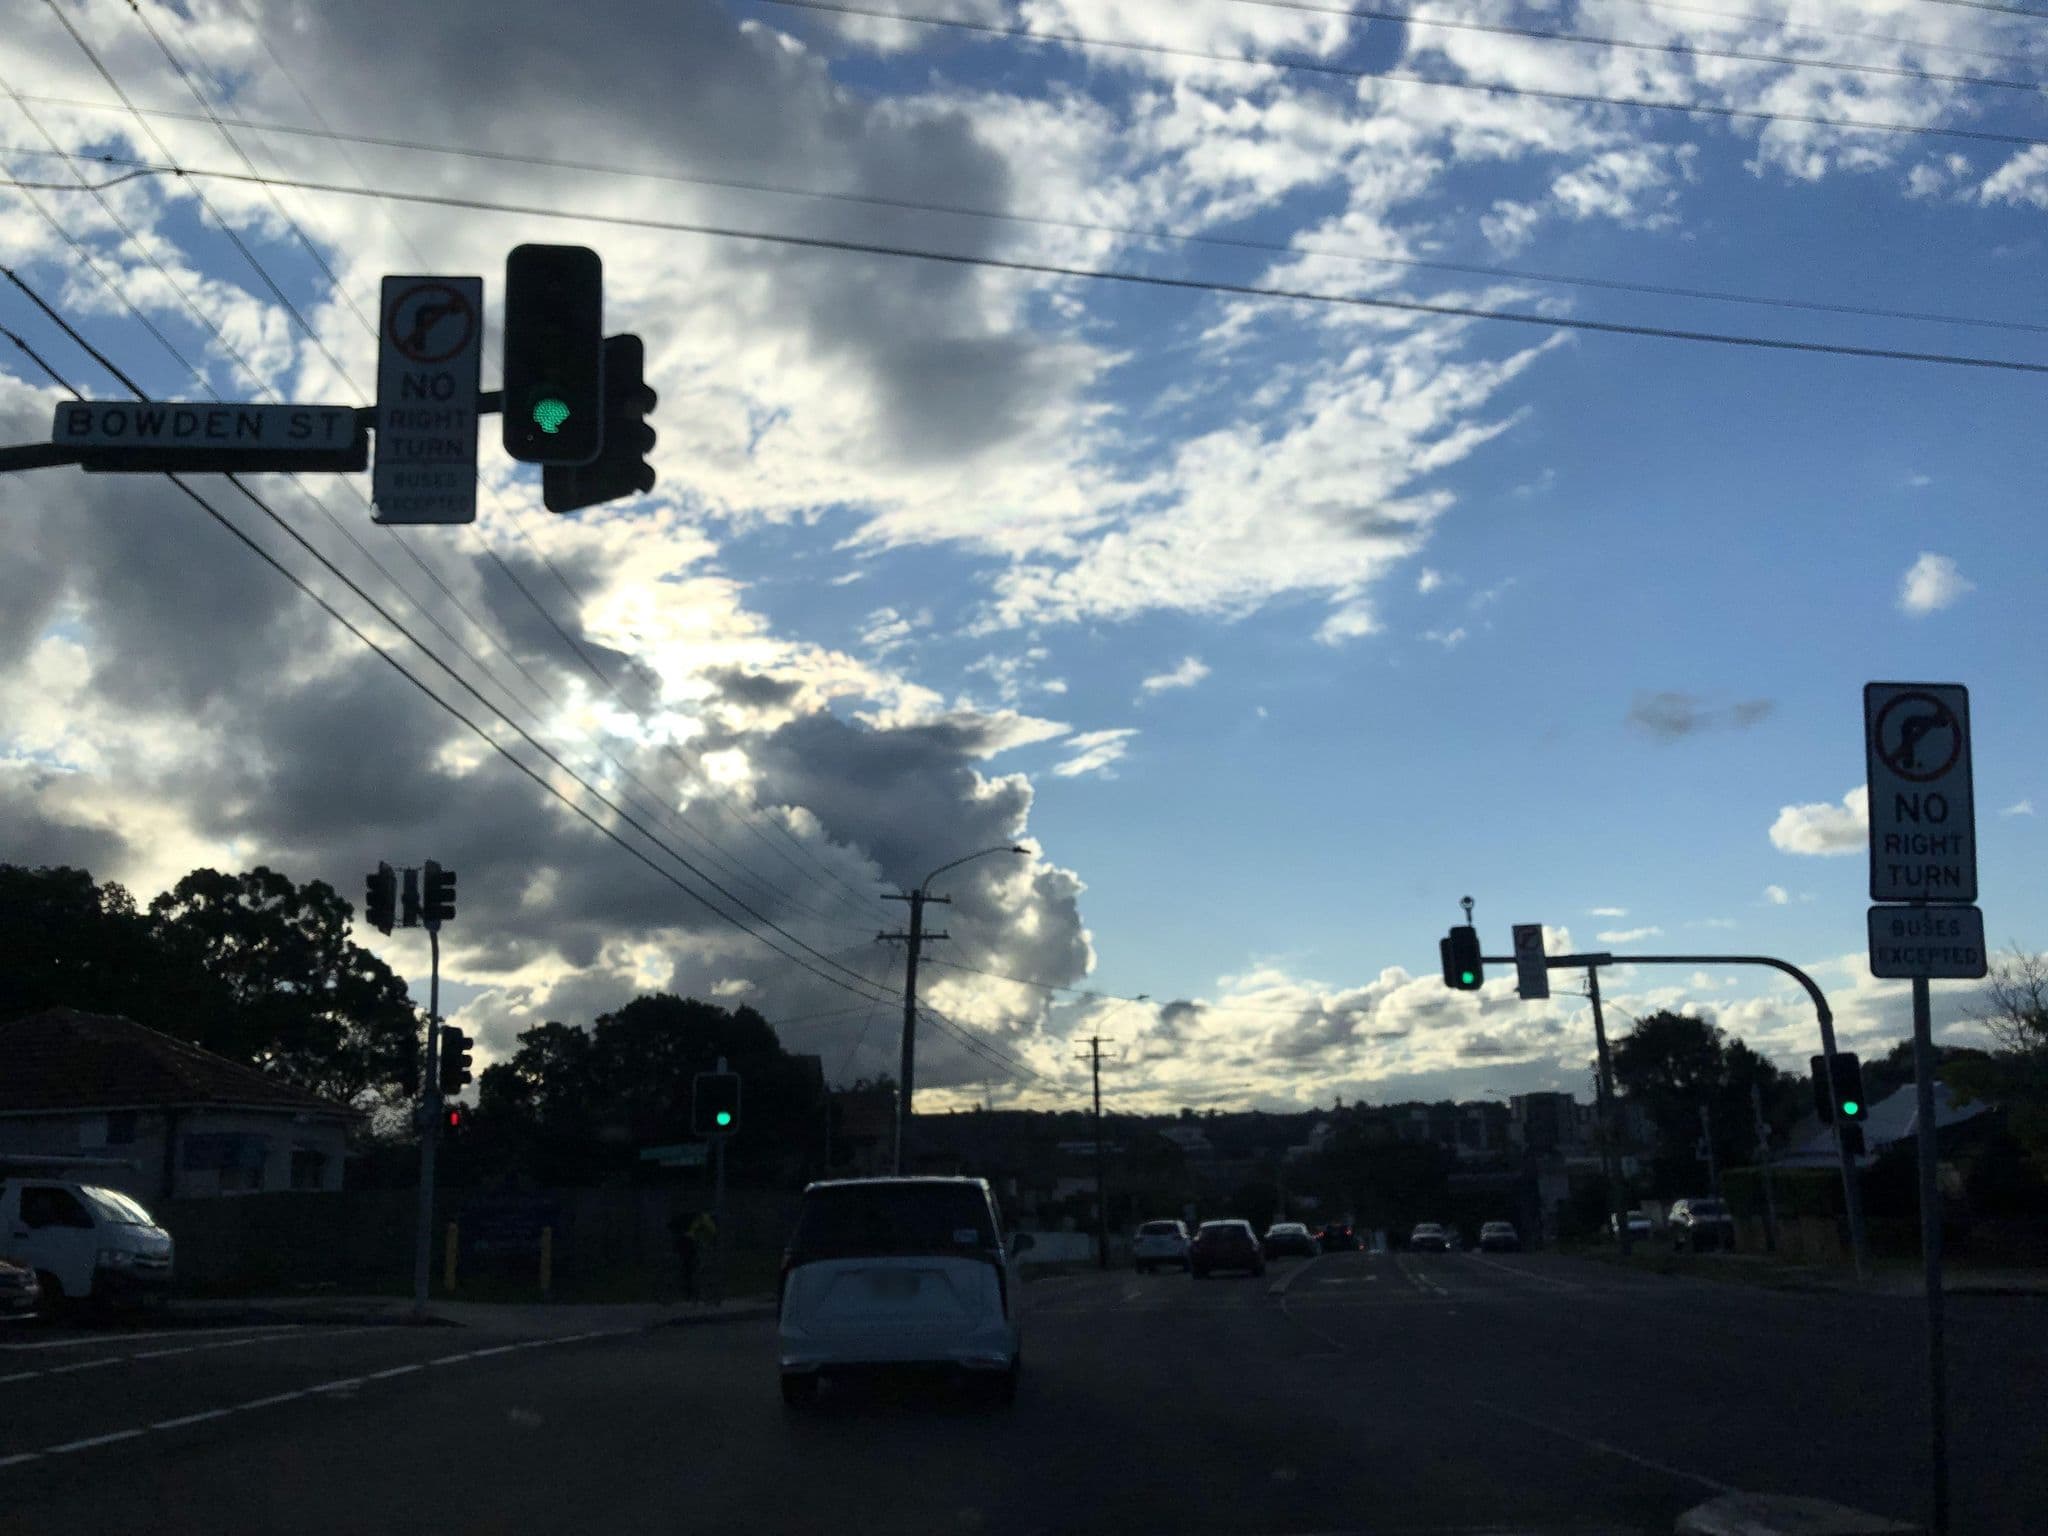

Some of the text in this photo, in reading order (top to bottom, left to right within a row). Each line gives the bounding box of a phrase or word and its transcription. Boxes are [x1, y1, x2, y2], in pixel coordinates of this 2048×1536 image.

[401, 372, 456, 399] NO
[67, 409, 343, 441] BOWDEN ST
[390, 407, 467, 430] RIGHT
[391, 436, 465, 458] TURN
[1895, 792, 1948, 823] NO
[1885, 833, 1963, 856] RIGHT
[1888, 864, 1961, 888] TURN
[1892, 918, 1961, 937] BUSES
[1878, 946, 1977, 965] EXCEPTED
